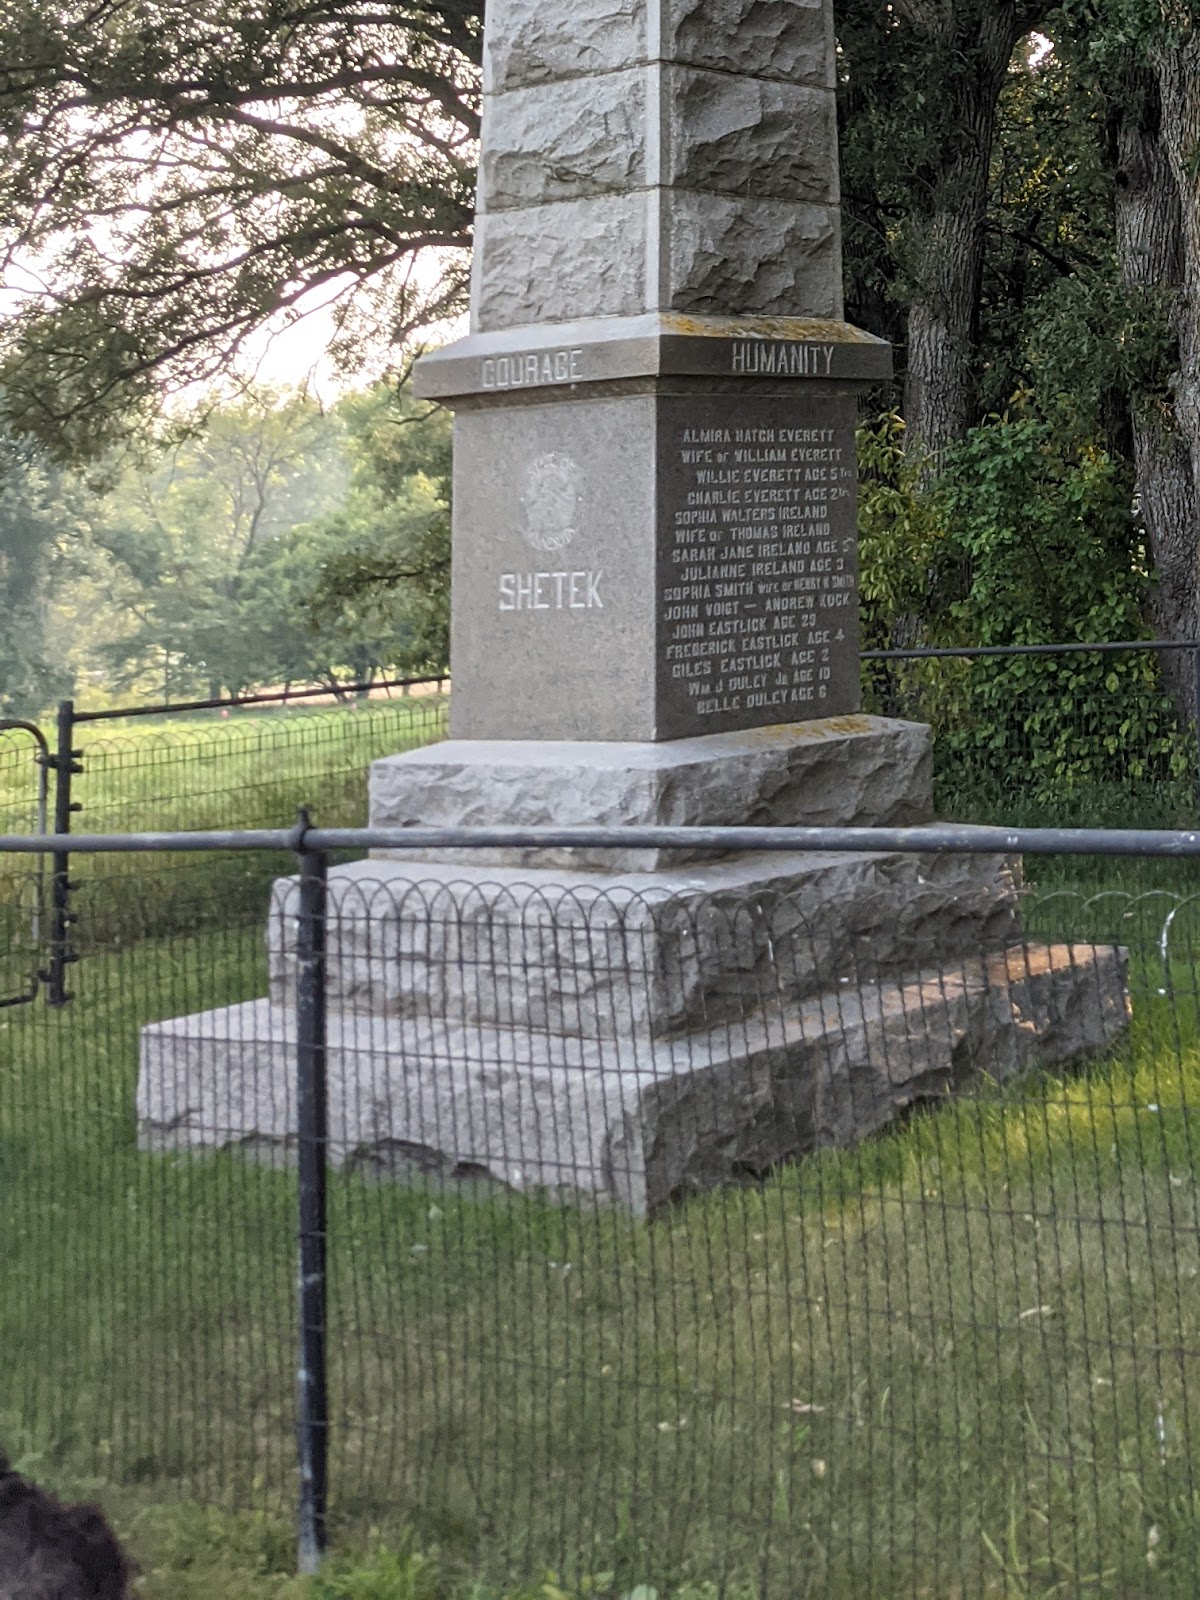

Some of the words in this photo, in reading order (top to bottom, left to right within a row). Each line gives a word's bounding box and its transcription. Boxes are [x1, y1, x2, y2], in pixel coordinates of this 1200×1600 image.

[482, 349, 583, 387] COURAGE
[732, 342, 835, 374] HUMANITY
[683, 429, 731, 443] ALMIRA
[735, 429, 775, 442] HATCH
[779, 429, 834, 442] EVERETT
[681, 450, 712, 463] WIFE
[734, 449, 787, 462] WILLIAM
[791, 448, 842, 461] EVERETT
[696, 469, 740, 484] WILLIE
[744, 469, 801, 483] EVERETT
[805, 468, 827, 481] AGE
[687, 490, 740, 505] CHARLIE
[745, 489, 800, 503] EVERETT
[805, 488, 827, 501] AGE
[674, 510, 717, 525] SOPHIA
[722, 508, 775, 523] WALTERS
[779, 505, 827, 520] IRELAND
[675, 529, 706, 543] WIFE
[730, 525, 778, 541] THOMAS
[783, 523, 830, 538] IRELAND
[672, 547, 716, 563] SARAH
[720, 545, 754, 560] JANE
[758, 542, 811, 558] IRELAND
[816, 540, 838, 553] AGE
[681, 564, 746, 581] JULIANNE
[752, 560, 804, 576] IRELAND
[810, 559, 832, 572] AGE
[499, 570, 604, 611] SHETEK
[663, 584, 711, 601] SOPHIA
[715, 581, 753, 597] SMITH
[664, 604, 699, 620] JOHN
[706, 601, 739, 616] VOIGT
[765, 595, 814, 611] ANDREW
[819, 592, 850, 607] KOCK
[672, 622, 705, 639] JOHN
[709, 617, 767, 636] EASTLICK
[773, 616, 796, 630] AGE
[666, 639, 736, 659] FREDERICK
[742, 633, 799, 652] EASTLICK
[808, 630, 830, 644] AGE
[672, 660, 711, 678] GILES
[721, 653, 781, 673] EASTLICK
[792, 649, 815, 665] AGE
[821, 648, 829, 662] 2
[729, 674, 768, 690] DULEY
[793, 669, 813, 683] AGE
[697, 696, 740, 714] BELLE
[747, 690, 787, 708] DULEY
[792, 687, 814, 701] AGE
